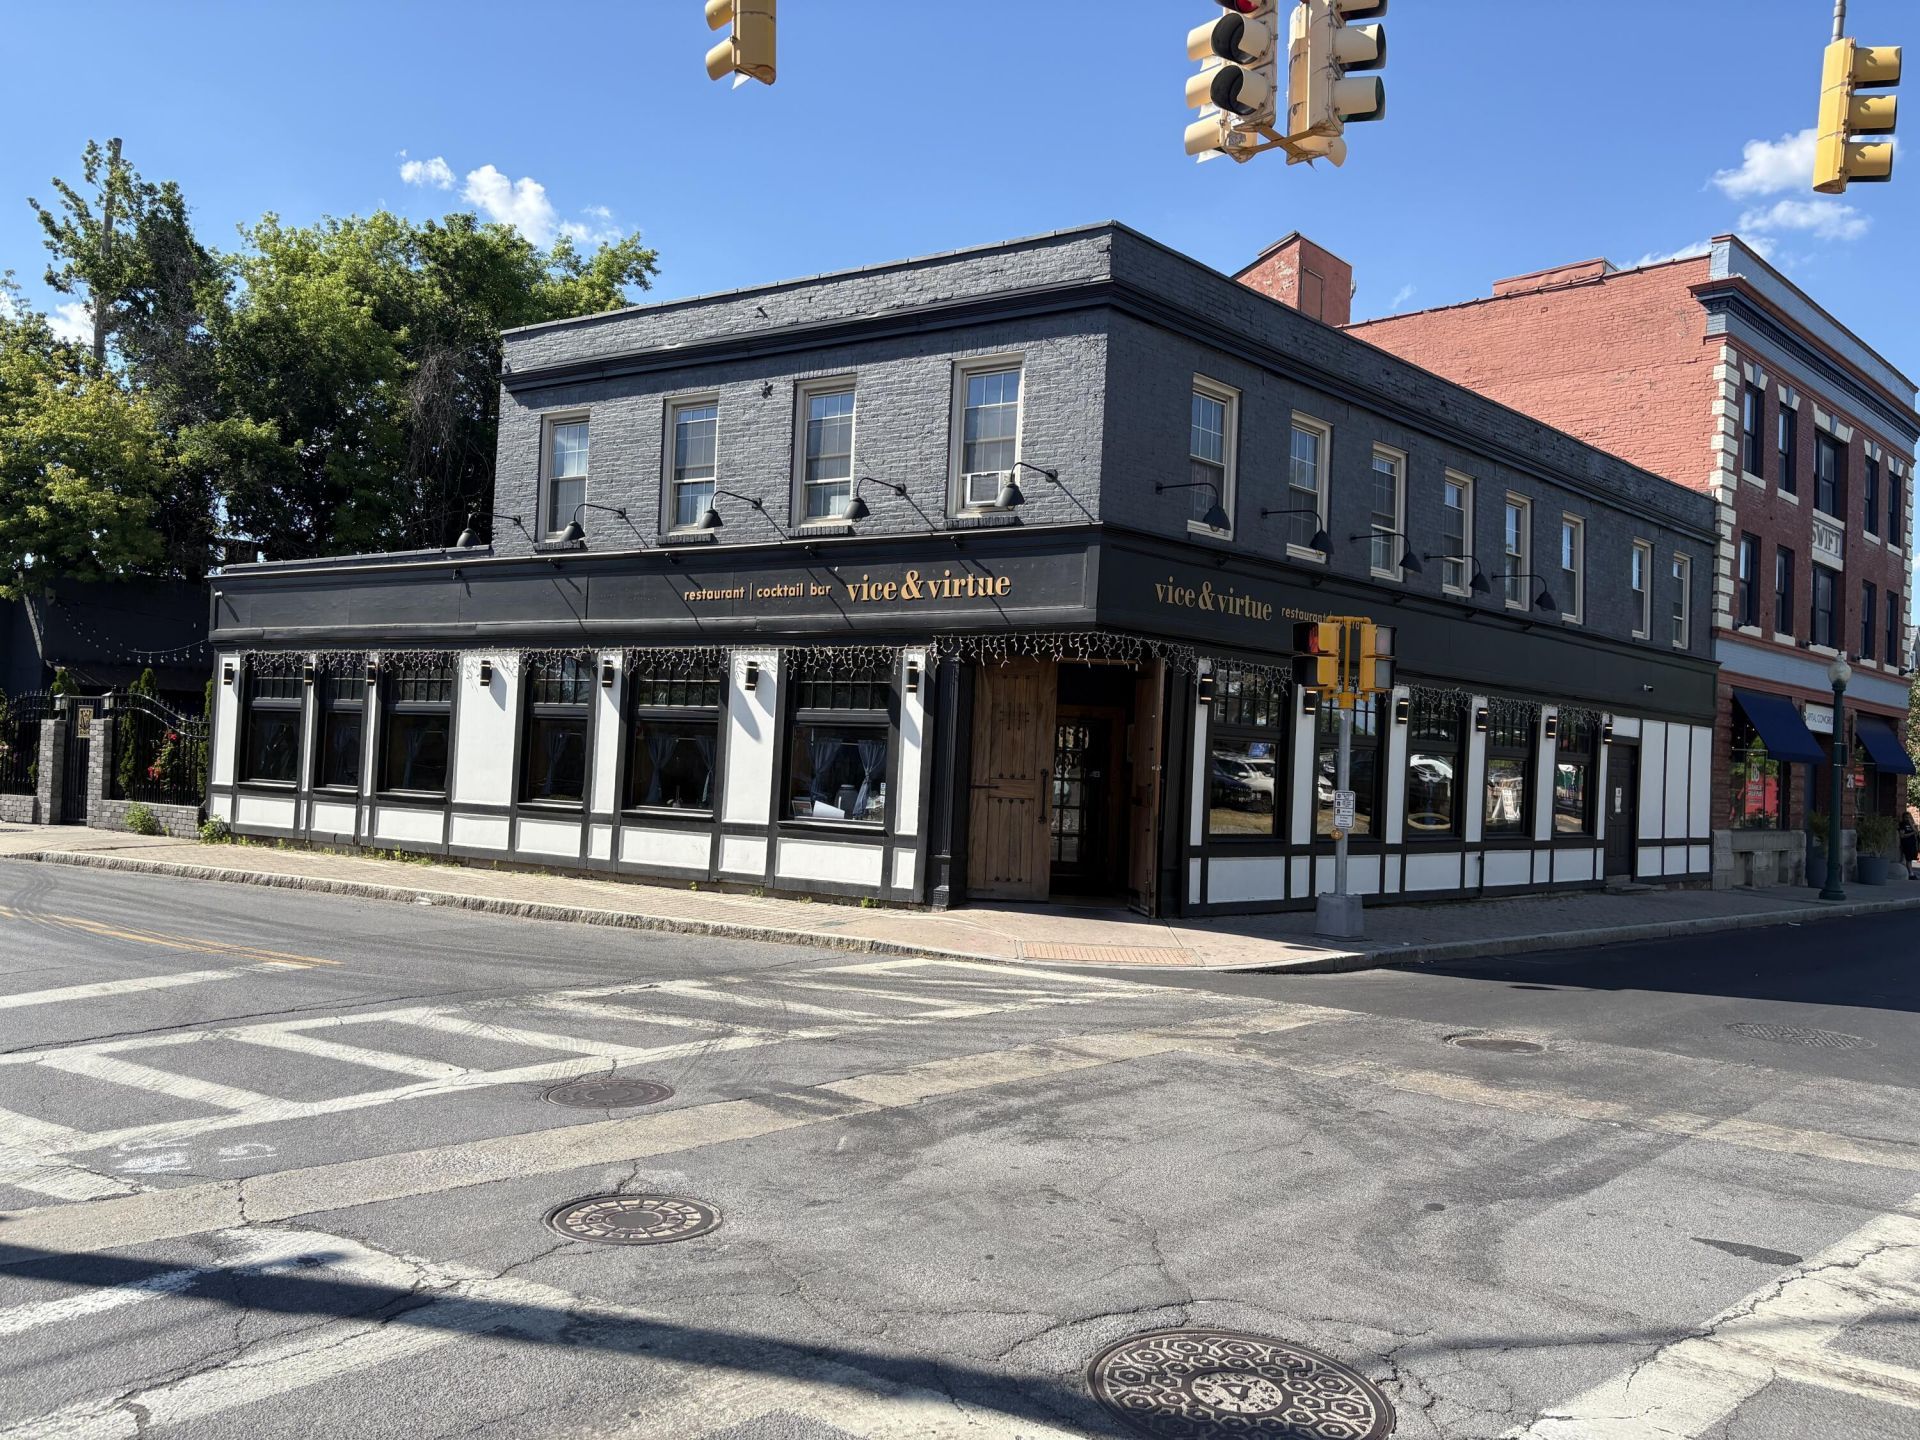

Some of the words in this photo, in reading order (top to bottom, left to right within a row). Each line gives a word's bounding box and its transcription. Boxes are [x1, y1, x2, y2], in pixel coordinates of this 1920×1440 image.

[684, 585, 746, 602] restaurant
[756, 582, 804, 599] cocktail
[810, 583, 832, 597] bar
